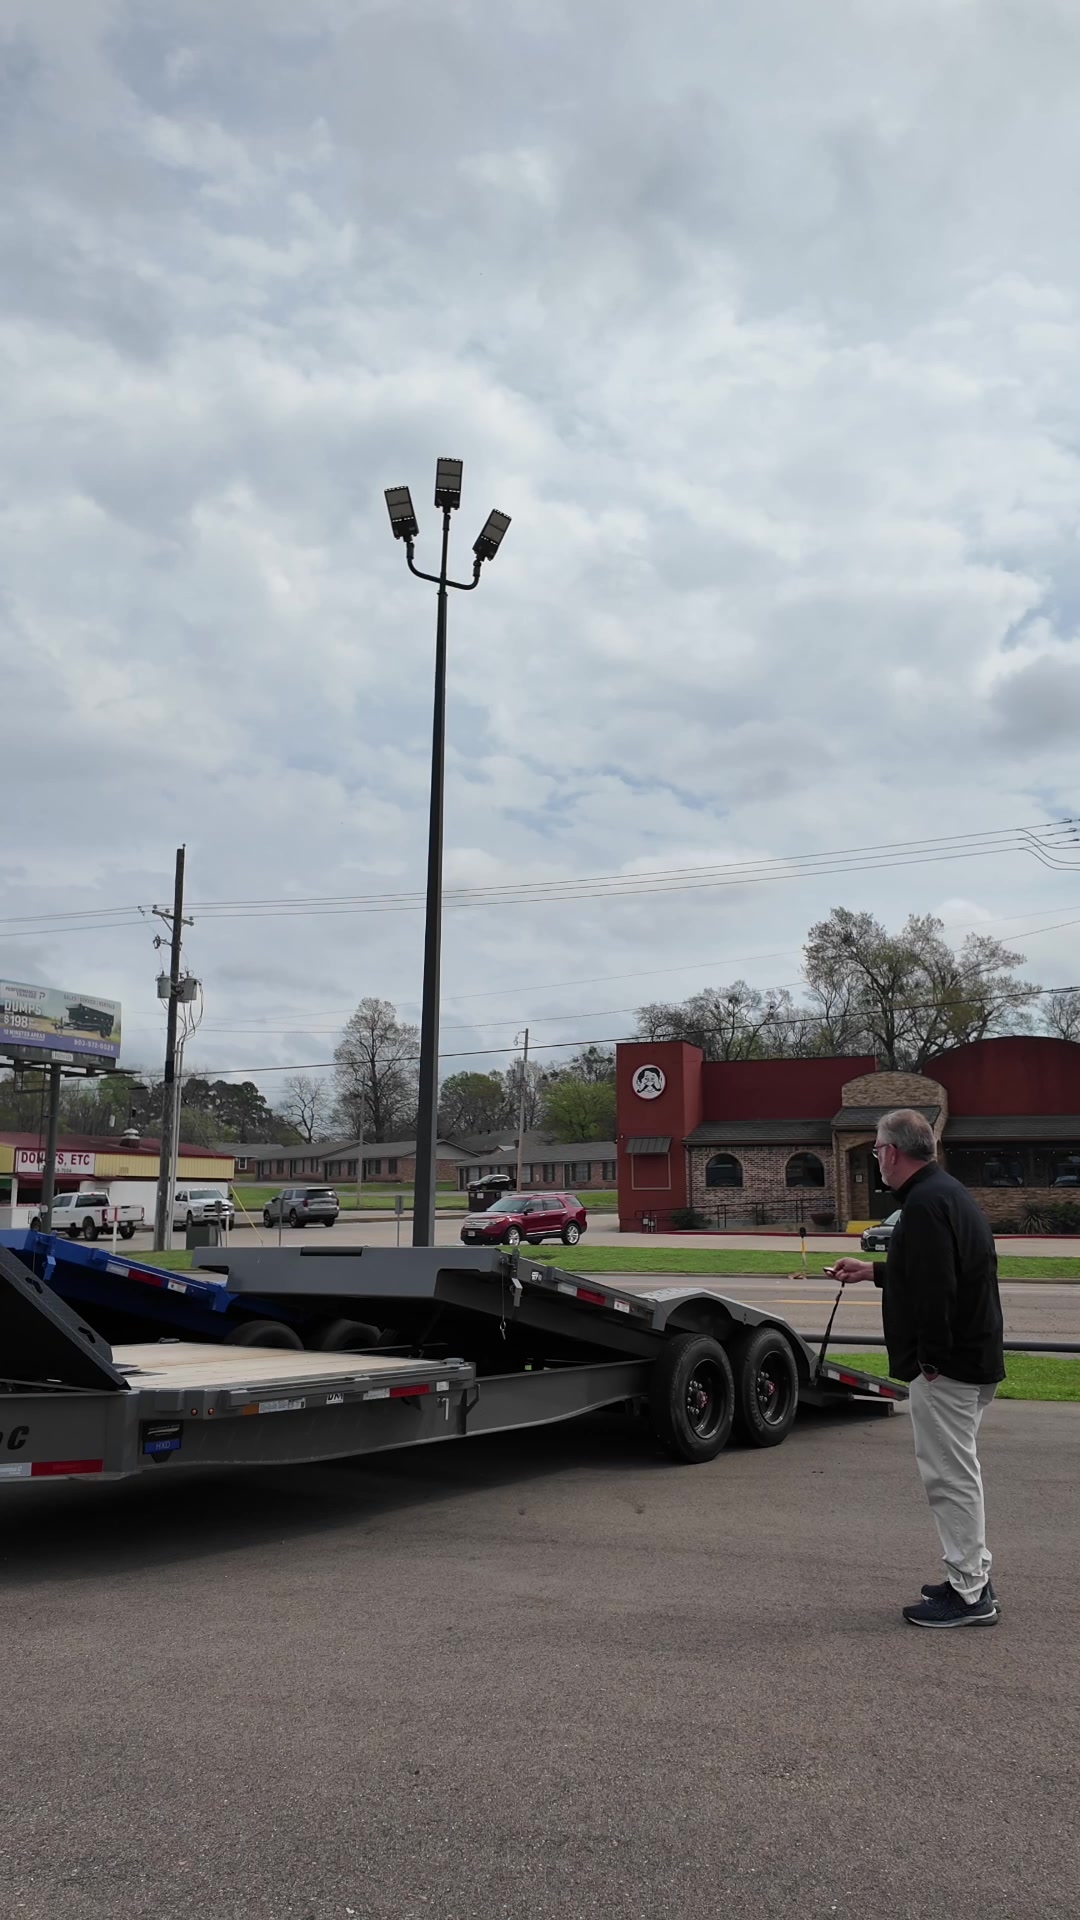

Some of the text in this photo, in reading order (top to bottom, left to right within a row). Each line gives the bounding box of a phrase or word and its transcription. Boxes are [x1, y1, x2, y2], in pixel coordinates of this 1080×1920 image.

[4, 1000, 42, 1016] DUMPS
[4, 1014, 28, 1028] $198
[71, 1154, 90, 1166] ETC
